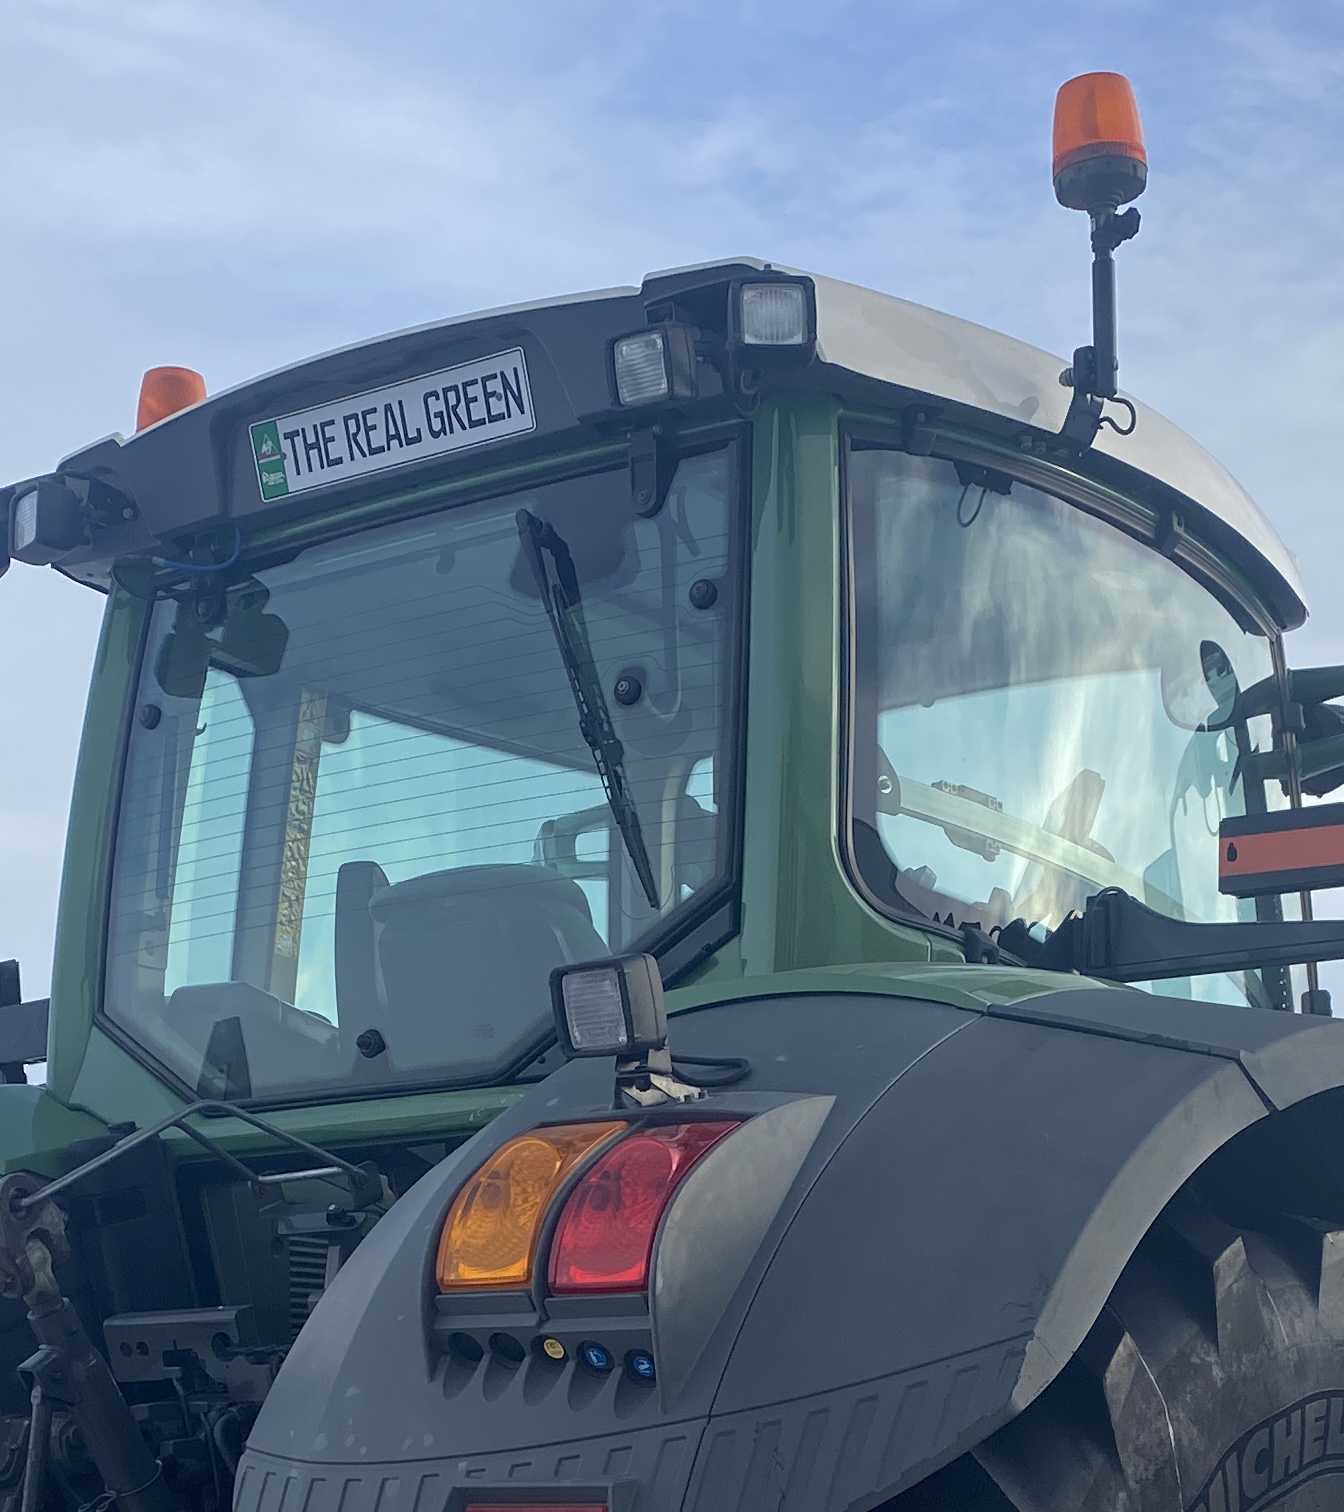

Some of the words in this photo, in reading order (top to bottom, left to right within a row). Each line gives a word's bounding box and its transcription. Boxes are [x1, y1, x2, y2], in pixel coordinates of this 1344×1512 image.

[283, 419, 343, 476] THE
[343, 400, 422, 461] REAL
[423, 367, 526, 439] GREEN
